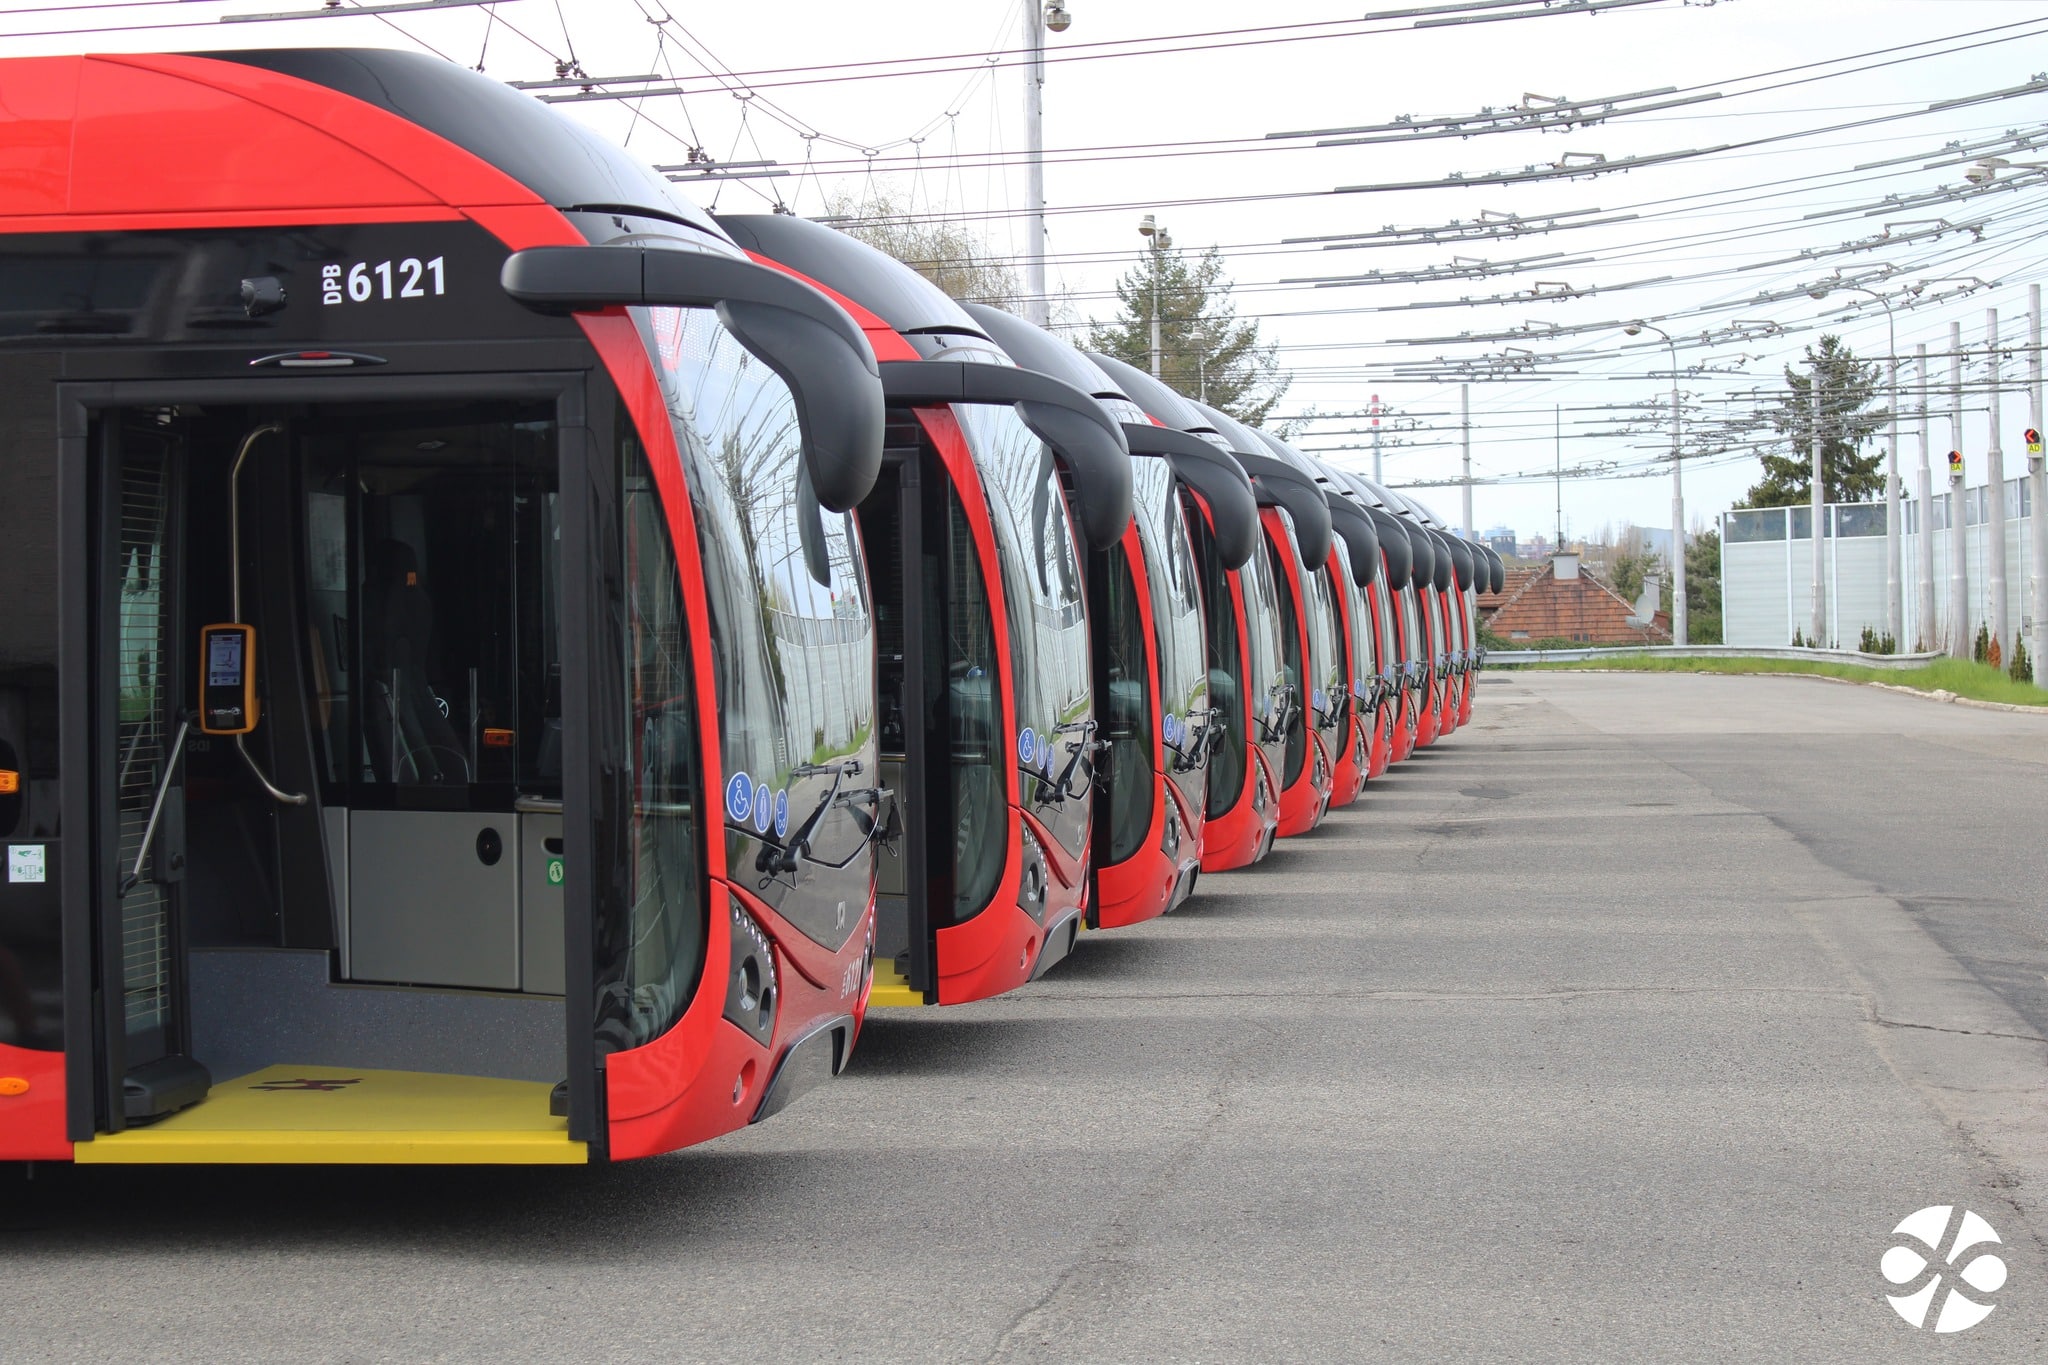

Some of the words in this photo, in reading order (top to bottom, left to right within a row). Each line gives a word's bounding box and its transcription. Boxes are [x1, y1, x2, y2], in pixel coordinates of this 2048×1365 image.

[322, 264, 343, 305] DPB
[347, 255, 445, 302] 6121
[2029, 444, 2040, 452] AD
